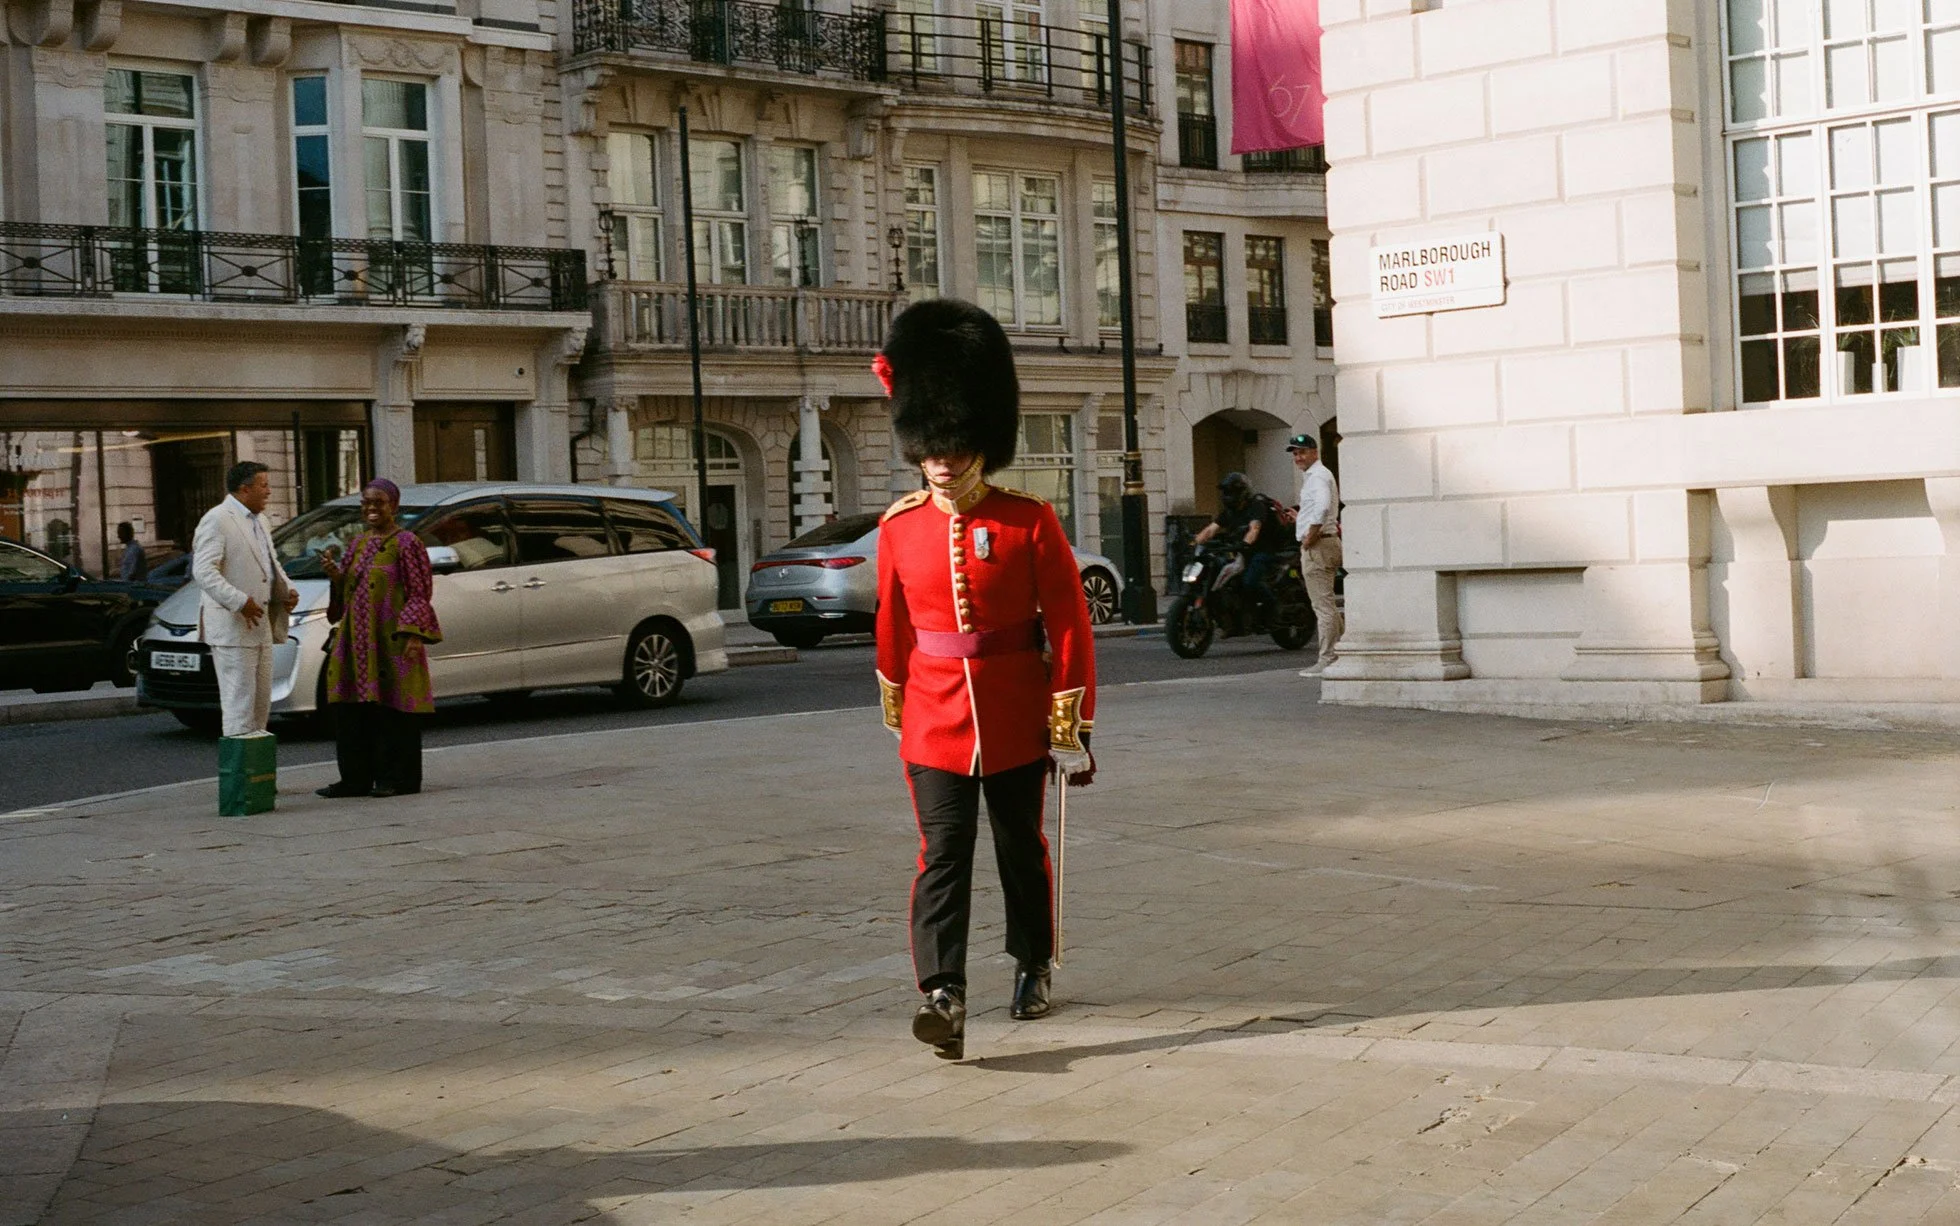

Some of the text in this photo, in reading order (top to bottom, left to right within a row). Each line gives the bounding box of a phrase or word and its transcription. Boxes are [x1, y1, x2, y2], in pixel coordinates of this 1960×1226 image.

[1267, 73, 1312, 128] 67
[1378, 240, 1491, 271] MARLBOROUGH
[1380, 268, 1455, 292] ROAD SW1
[1381, 302, 1396, 312] CITY
[1407, 296, 1456, 309] WESTMINSTER
